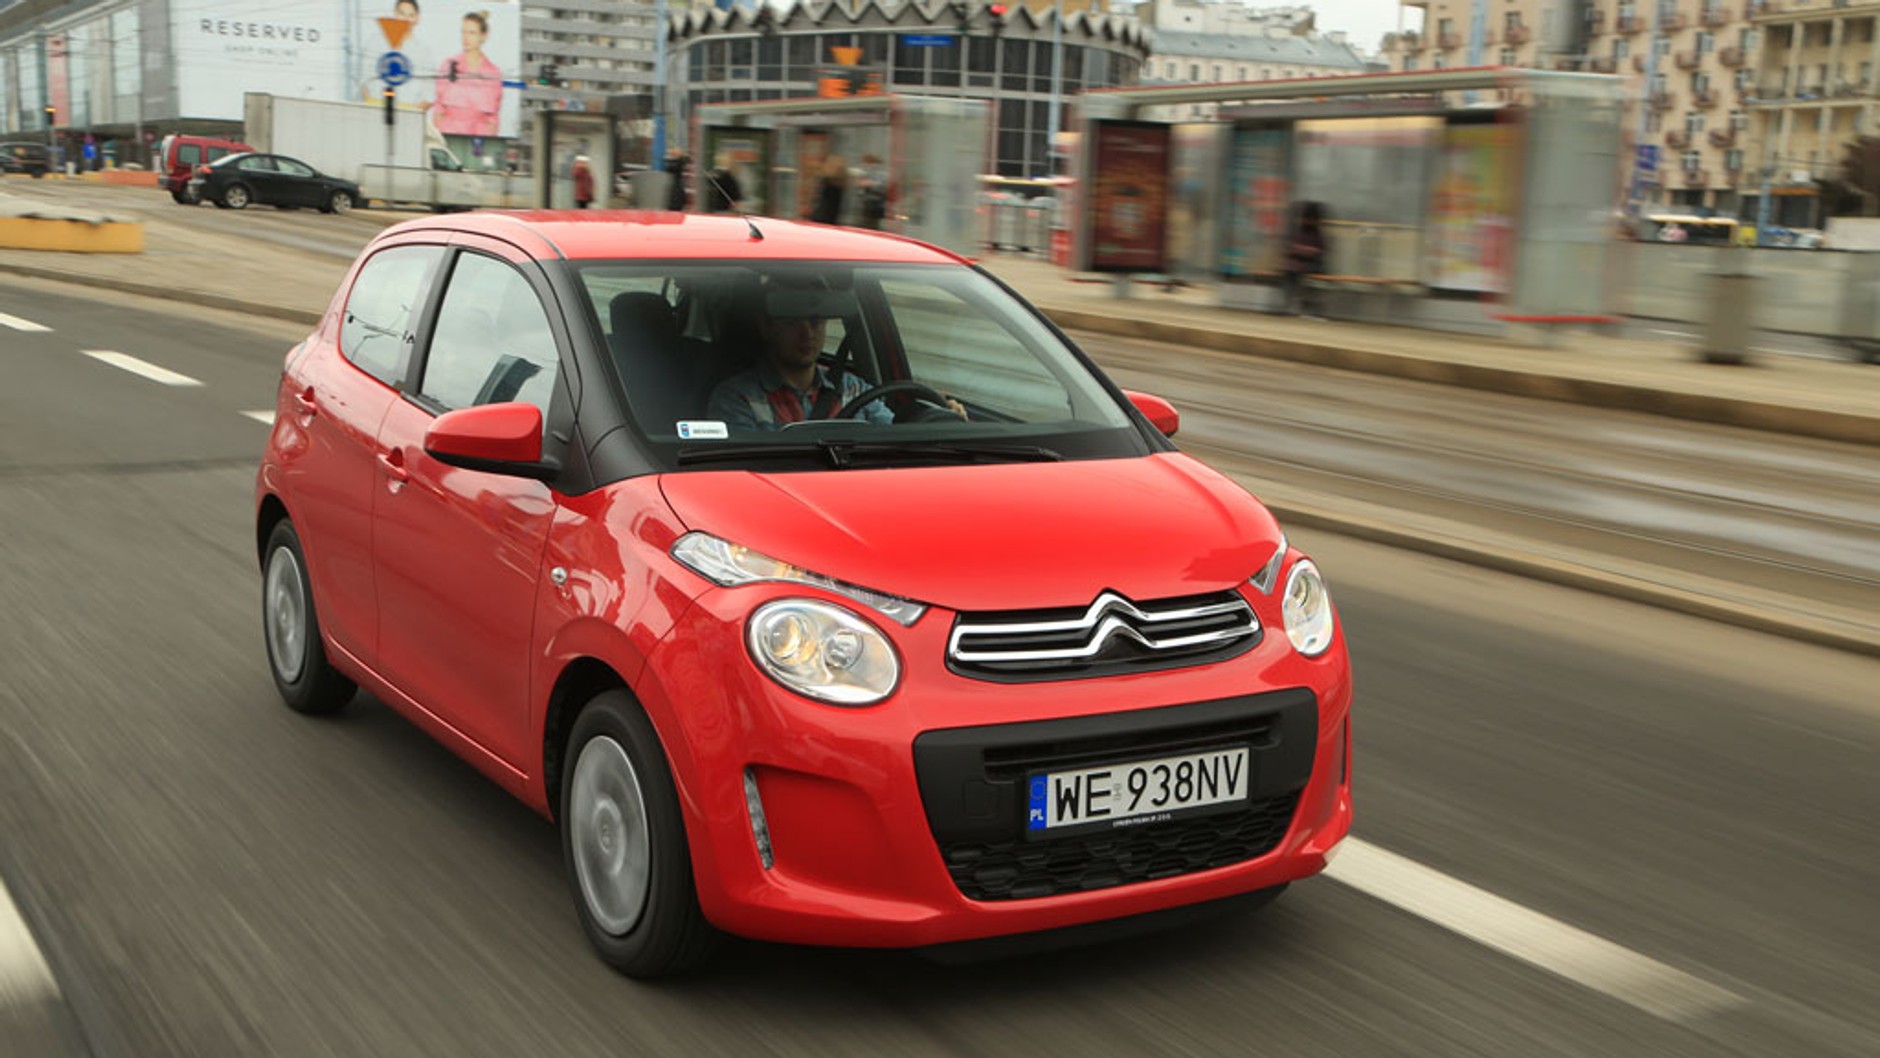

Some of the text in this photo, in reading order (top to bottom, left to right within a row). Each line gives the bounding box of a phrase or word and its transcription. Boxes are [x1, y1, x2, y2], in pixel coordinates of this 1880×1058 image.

[200, 18, 320, 42] RESERVED
[1055, 753, 1243, 822] WE 938NV
[1030, 808, 1044, 822] PL
